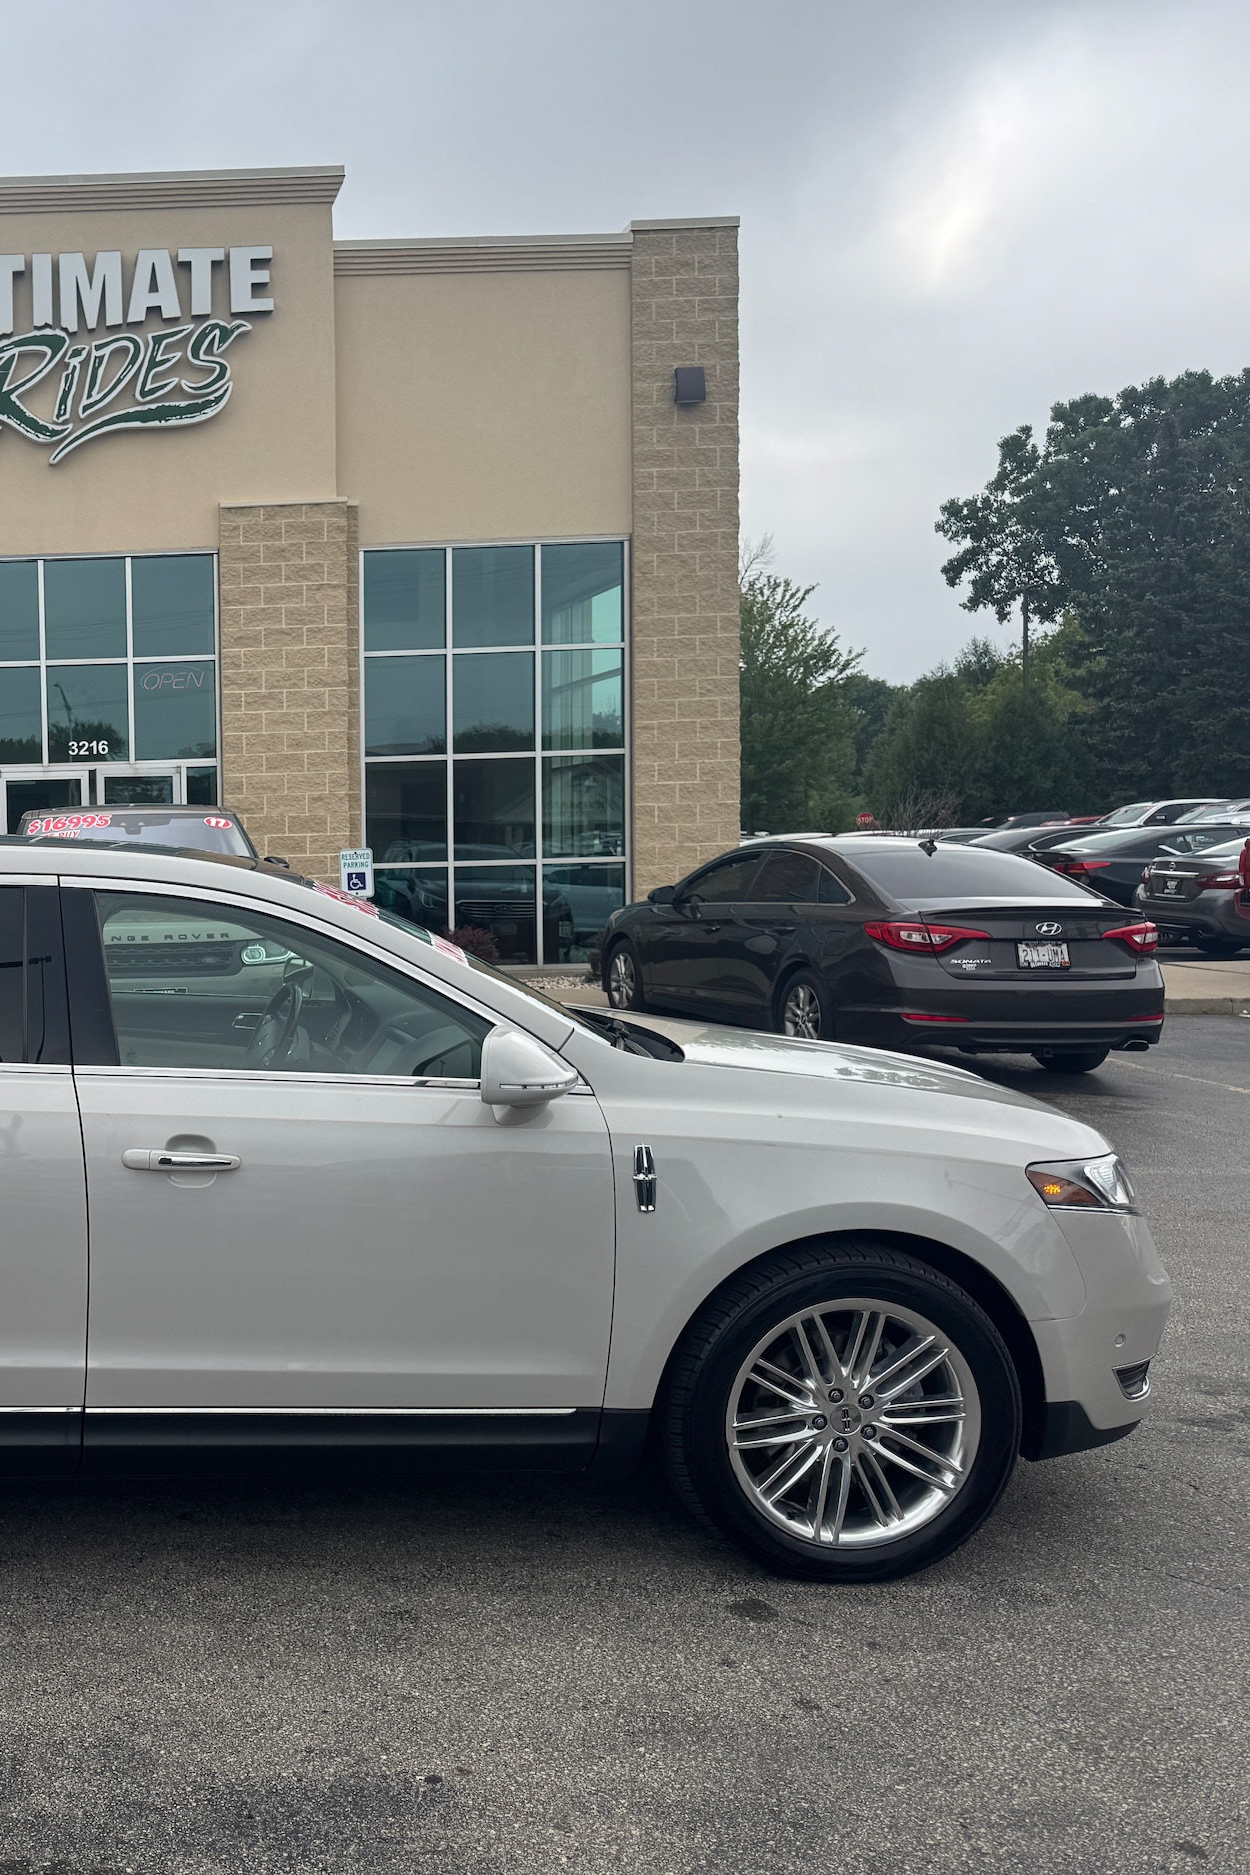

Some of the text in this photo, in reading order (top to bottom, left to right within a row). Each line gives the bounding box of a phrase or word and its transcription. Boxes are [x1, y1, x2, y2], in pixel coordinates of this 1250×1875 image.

[143, 671, 205, 690] OPEN
[68, 740, 109, 756] 3216
[28, 814, 112, 835] $16995
[857, 816, 873, 824] STOP
[341, 852, 370, 861] RESERVED
[343, 861, 369, 869] PARKING
[164, 932, 230, 941] ROVER
